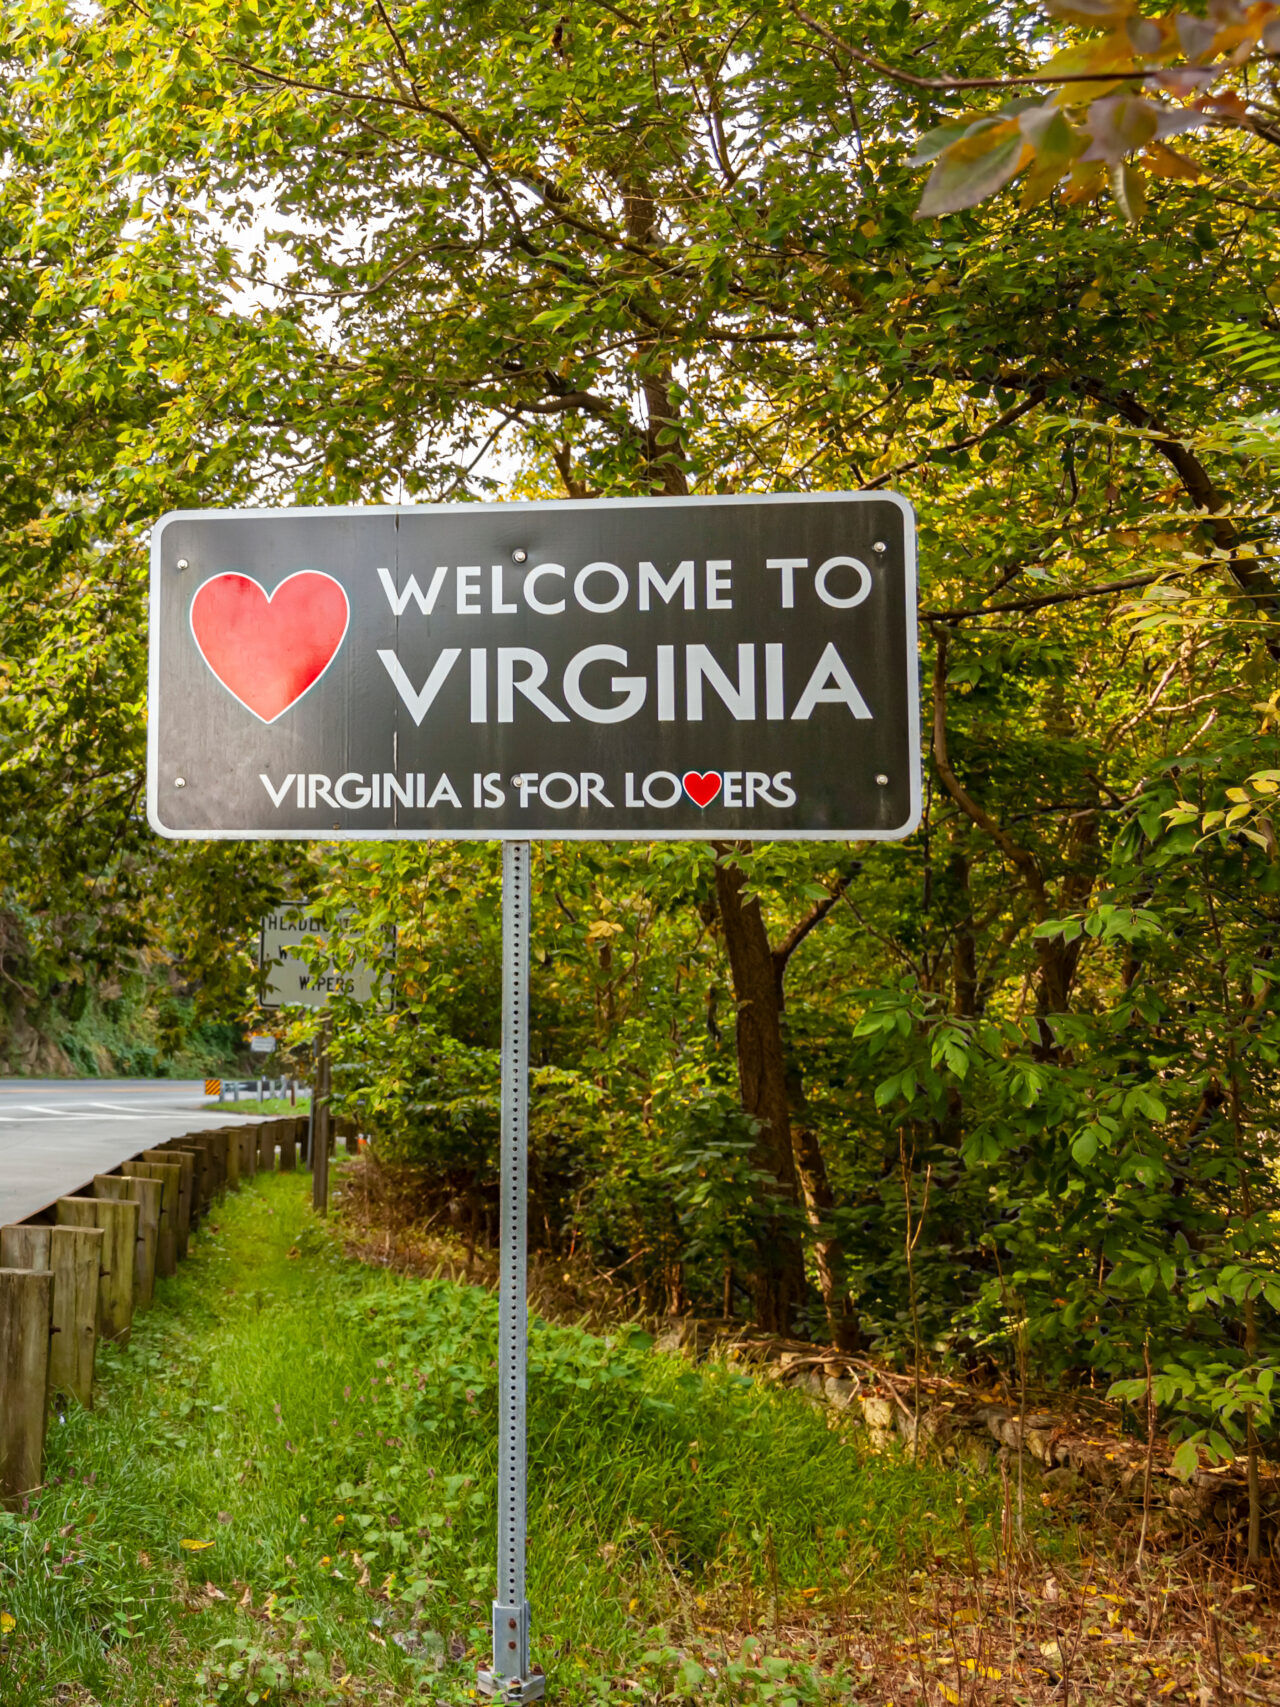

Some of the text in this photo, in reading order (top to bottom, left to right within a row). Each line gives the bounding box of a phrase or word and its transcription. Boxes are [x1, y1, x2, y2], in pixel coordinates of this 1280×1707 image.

[376, 556, 873, 617] WELCOME TO
[376, 642, 873, 727] VIRGINIA
[260, 772, 463, 809] VIRGINIA
[473, 773, 506, 809] IS
[519, 771, 616, 810] FOR
